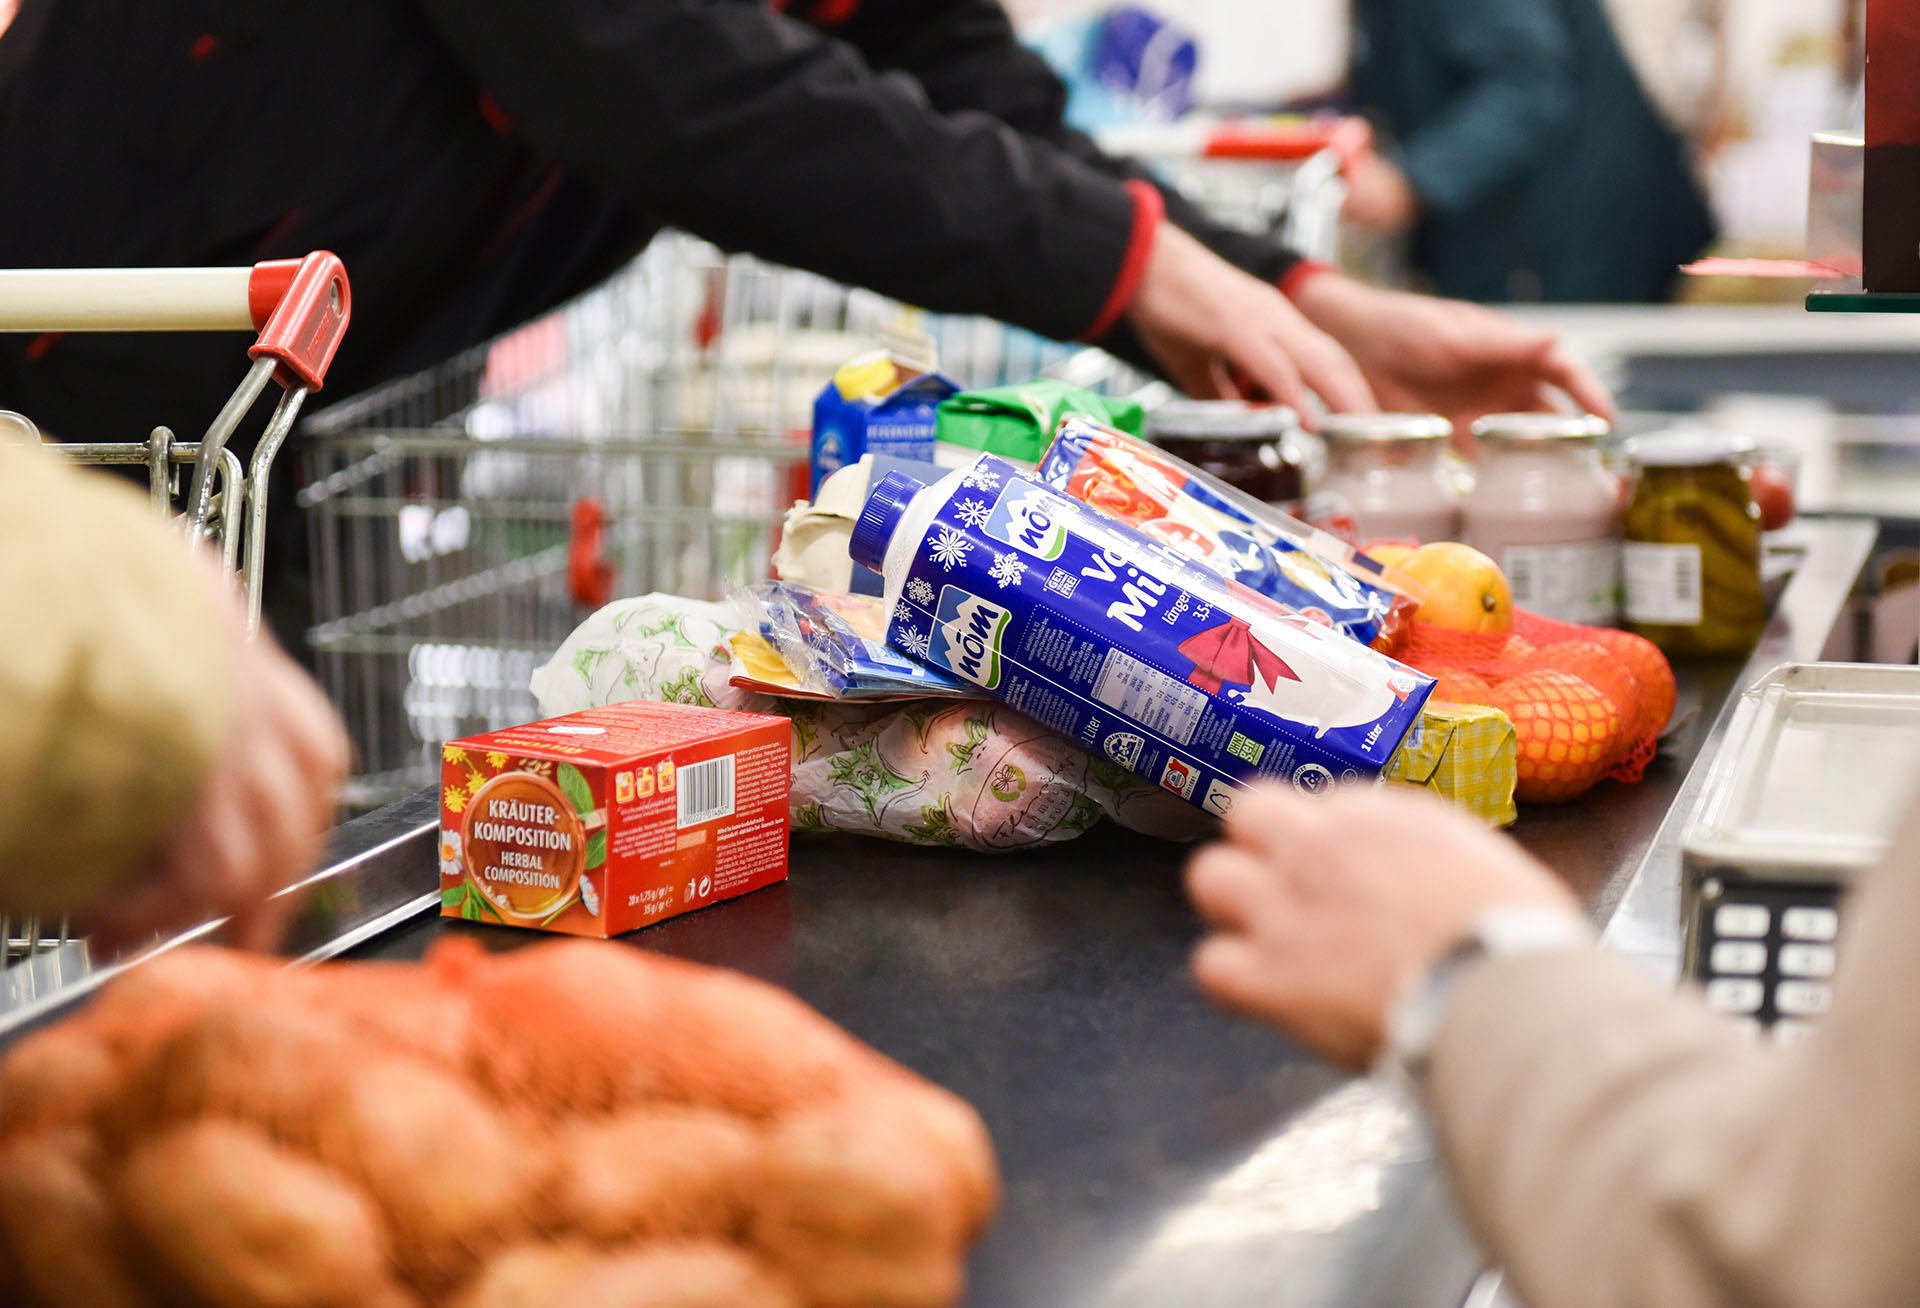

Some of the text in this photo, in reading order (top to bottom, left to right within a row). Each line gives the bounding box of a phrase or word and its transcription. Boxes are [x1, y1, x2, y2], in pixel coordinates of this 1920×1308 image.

[1049, 569, 1065, 589] GEN
[1060, 575, 1077, 597] FREI
[1107, 542, 1190, 632] Mih
[1161, 590, 1191, 626] länger
[1081, 716, 1101, 745] 1 Liter
[1361, 723, 1384, 752] 1 Liter
[1229, 733, 1245, 755] OHNE
[1239, 739, 1257, 762] gen
[489, 799, 560, 825] KRÄUTER-
[474, 821, 571, 851] KOMPOSITION
[501, 851, 543, 870] HERBAL
[484, 865, 560, 889] COMPOSITION
